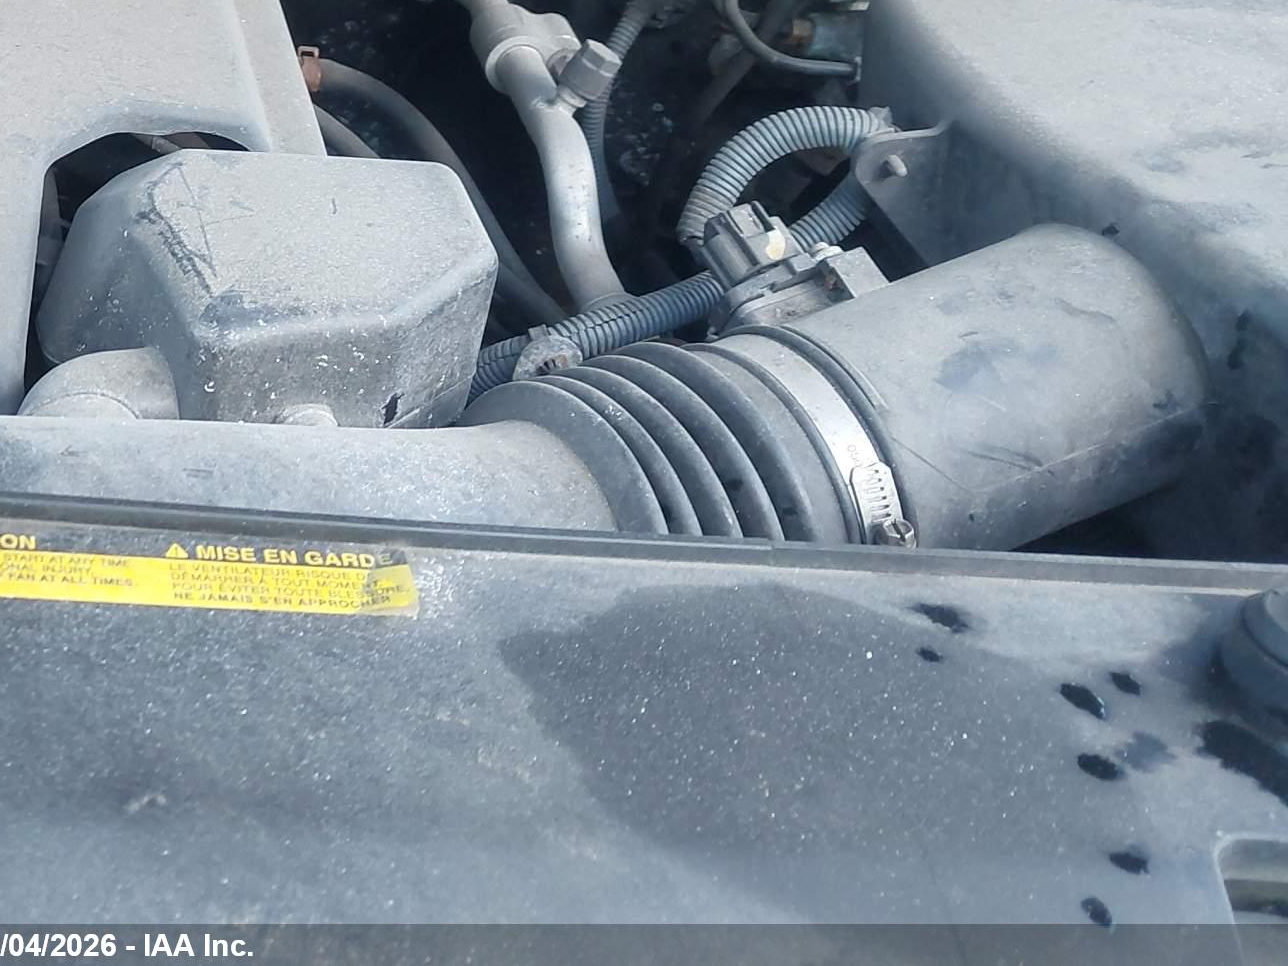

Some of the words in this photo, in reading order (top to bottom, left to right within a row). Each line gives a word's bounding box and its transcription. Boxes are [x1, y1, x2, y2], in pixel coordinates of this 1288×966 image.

[195, 544, 257, 563] MISE
[263, 548, 297, 565] EN
[304, 550, 393, 569] GARDE
[8, 573, 35, 582] FAN
[40, 574, 57, 583] AT
[61, 576, 87, 585] ALL
[174, 592, 193, 601] NE
[198, 594, 254, 605] JAMAIS
